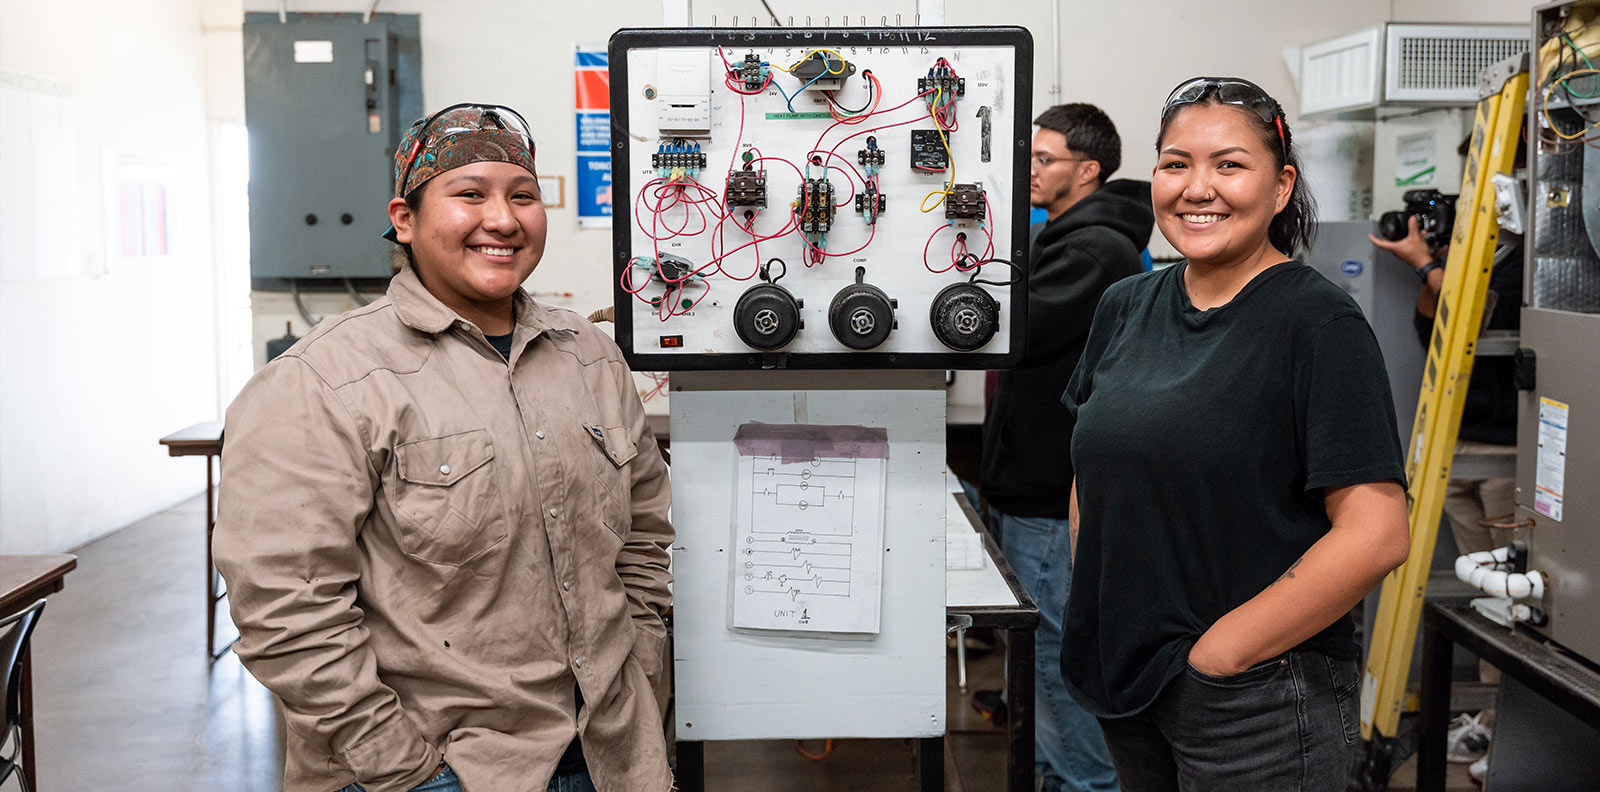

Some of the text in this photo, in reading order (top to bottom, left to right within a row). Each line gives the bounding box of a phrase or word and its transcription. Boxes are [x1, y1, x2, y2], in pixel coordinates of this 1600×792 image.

[850, 47, 857, 55] 8
[880, 47, 890, 55] 10
[902, 47, 909, 55] 11
[919, 47, 929, 55] 12
[976, 106, 992, 164] 1
[800, 608, 810, 619] 1
